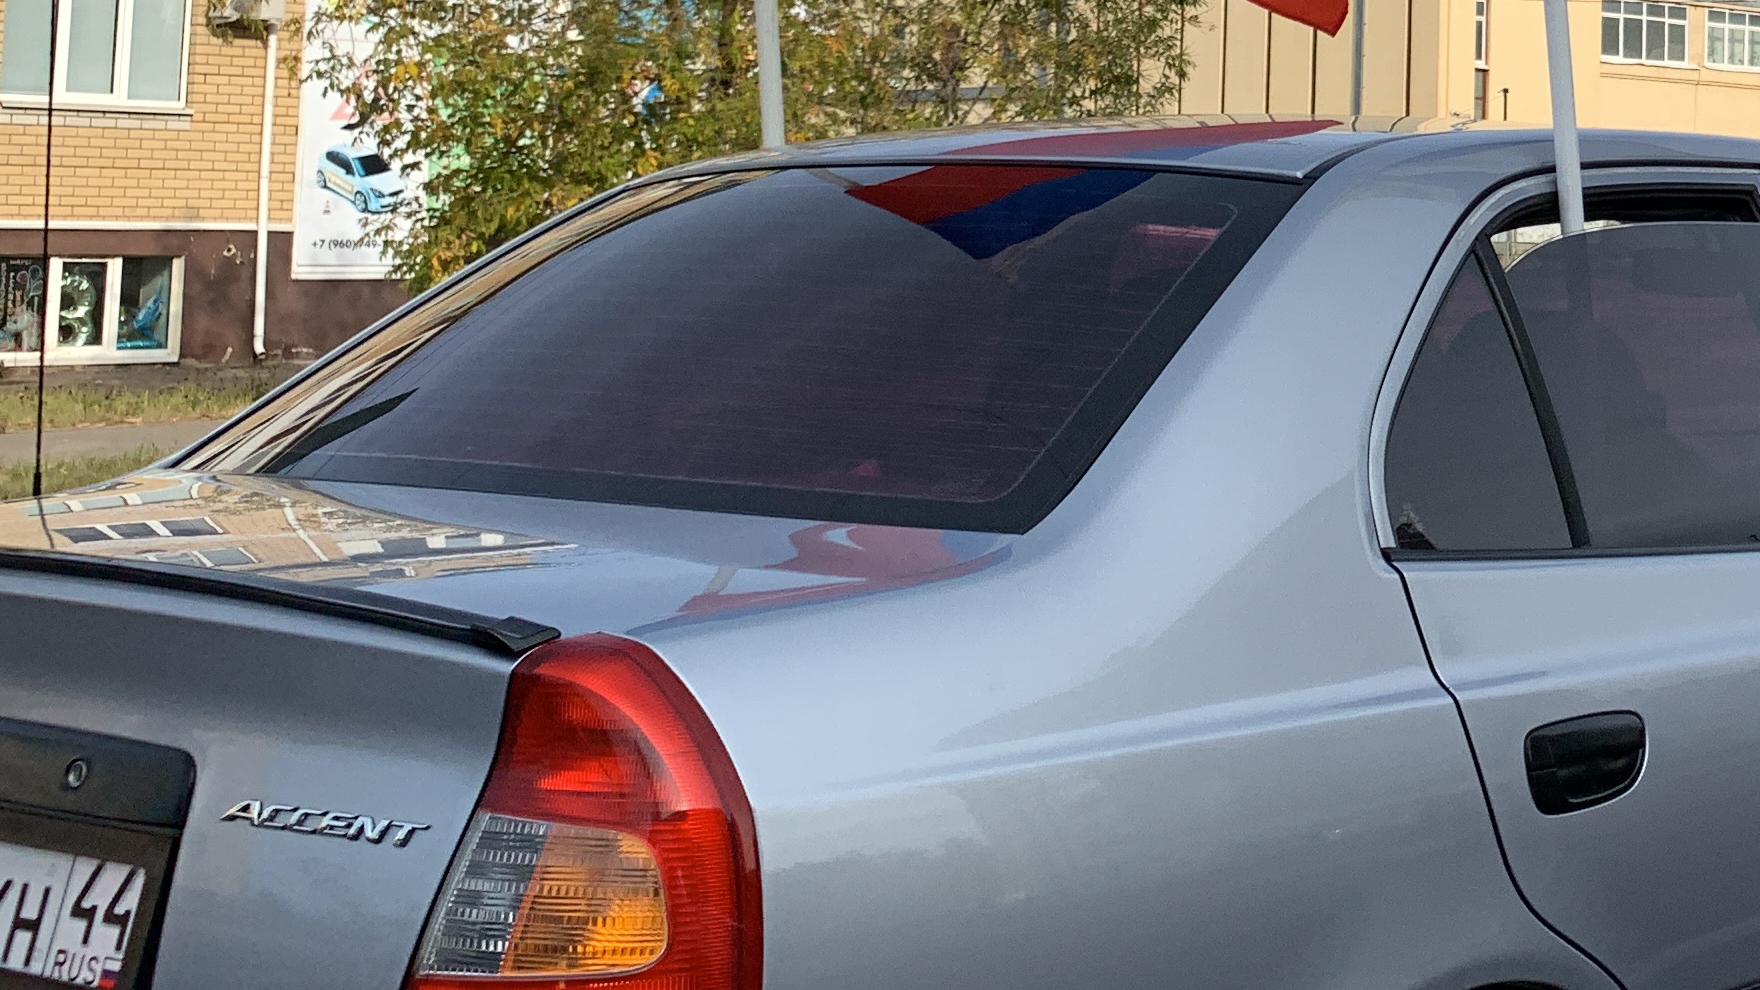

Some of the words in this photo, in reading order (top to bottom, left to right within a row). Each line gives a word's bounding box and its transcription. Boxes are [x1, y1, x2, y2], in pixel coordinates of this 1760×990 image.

[219, 798, 431, 848] ACCENT
[69, 859, 138, 952] 44
[50, 948, 99, 986] RUS
